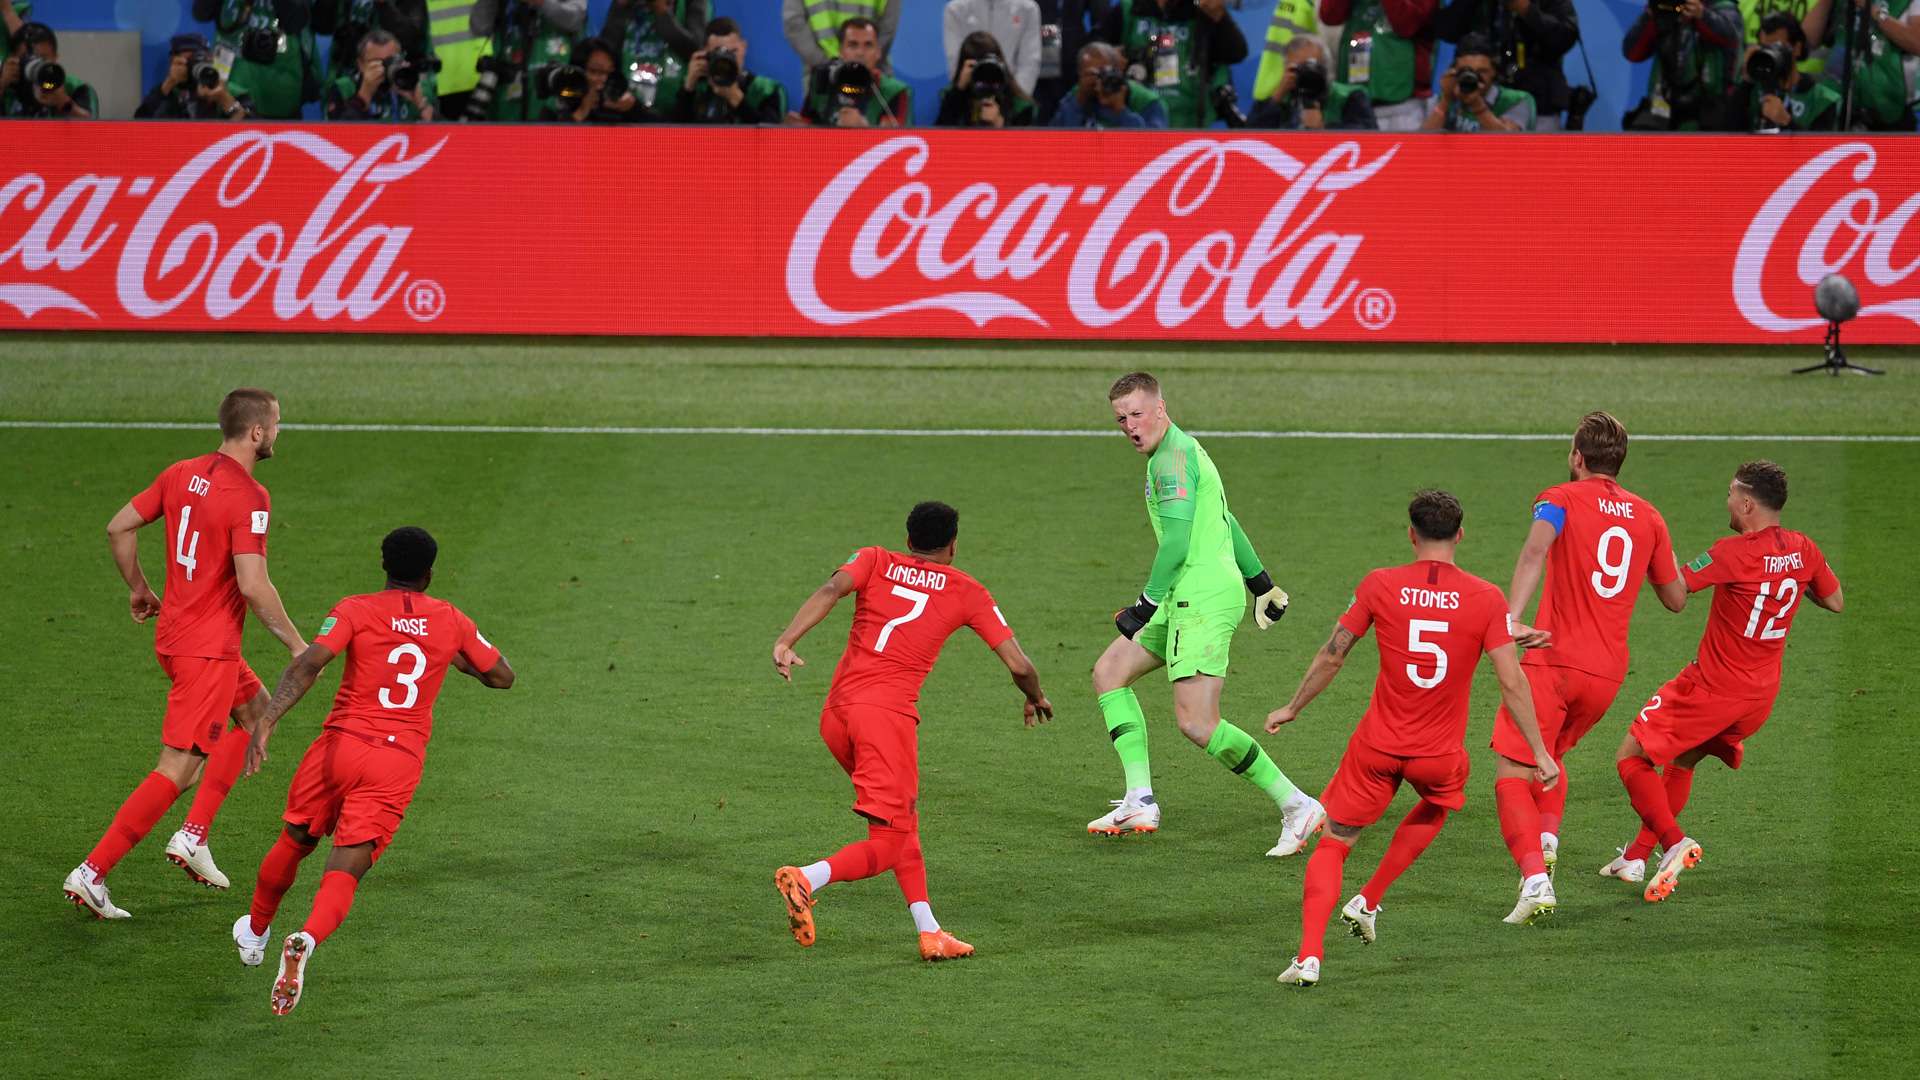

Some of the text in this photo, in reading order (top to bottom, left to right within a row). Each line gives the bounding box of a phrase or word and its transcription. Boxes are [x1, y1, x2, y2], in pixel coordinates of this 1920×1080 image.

[785, 135, 1400, 330] Coca-Cola
[1597, 497, 1635, 519] KANE
[176, 505, 200, 581] 4
[884, 562, 947, 592] LINGARD
[1591, 525, 1633, 599] 9
[874, 584, 930, 653] 7
[1399, 586, 1460, 610] STONES
[1743, 577, 1798, 640] 12
[378, 642, 427, 709] 3
[1406, 618, 1449, 689] 5
